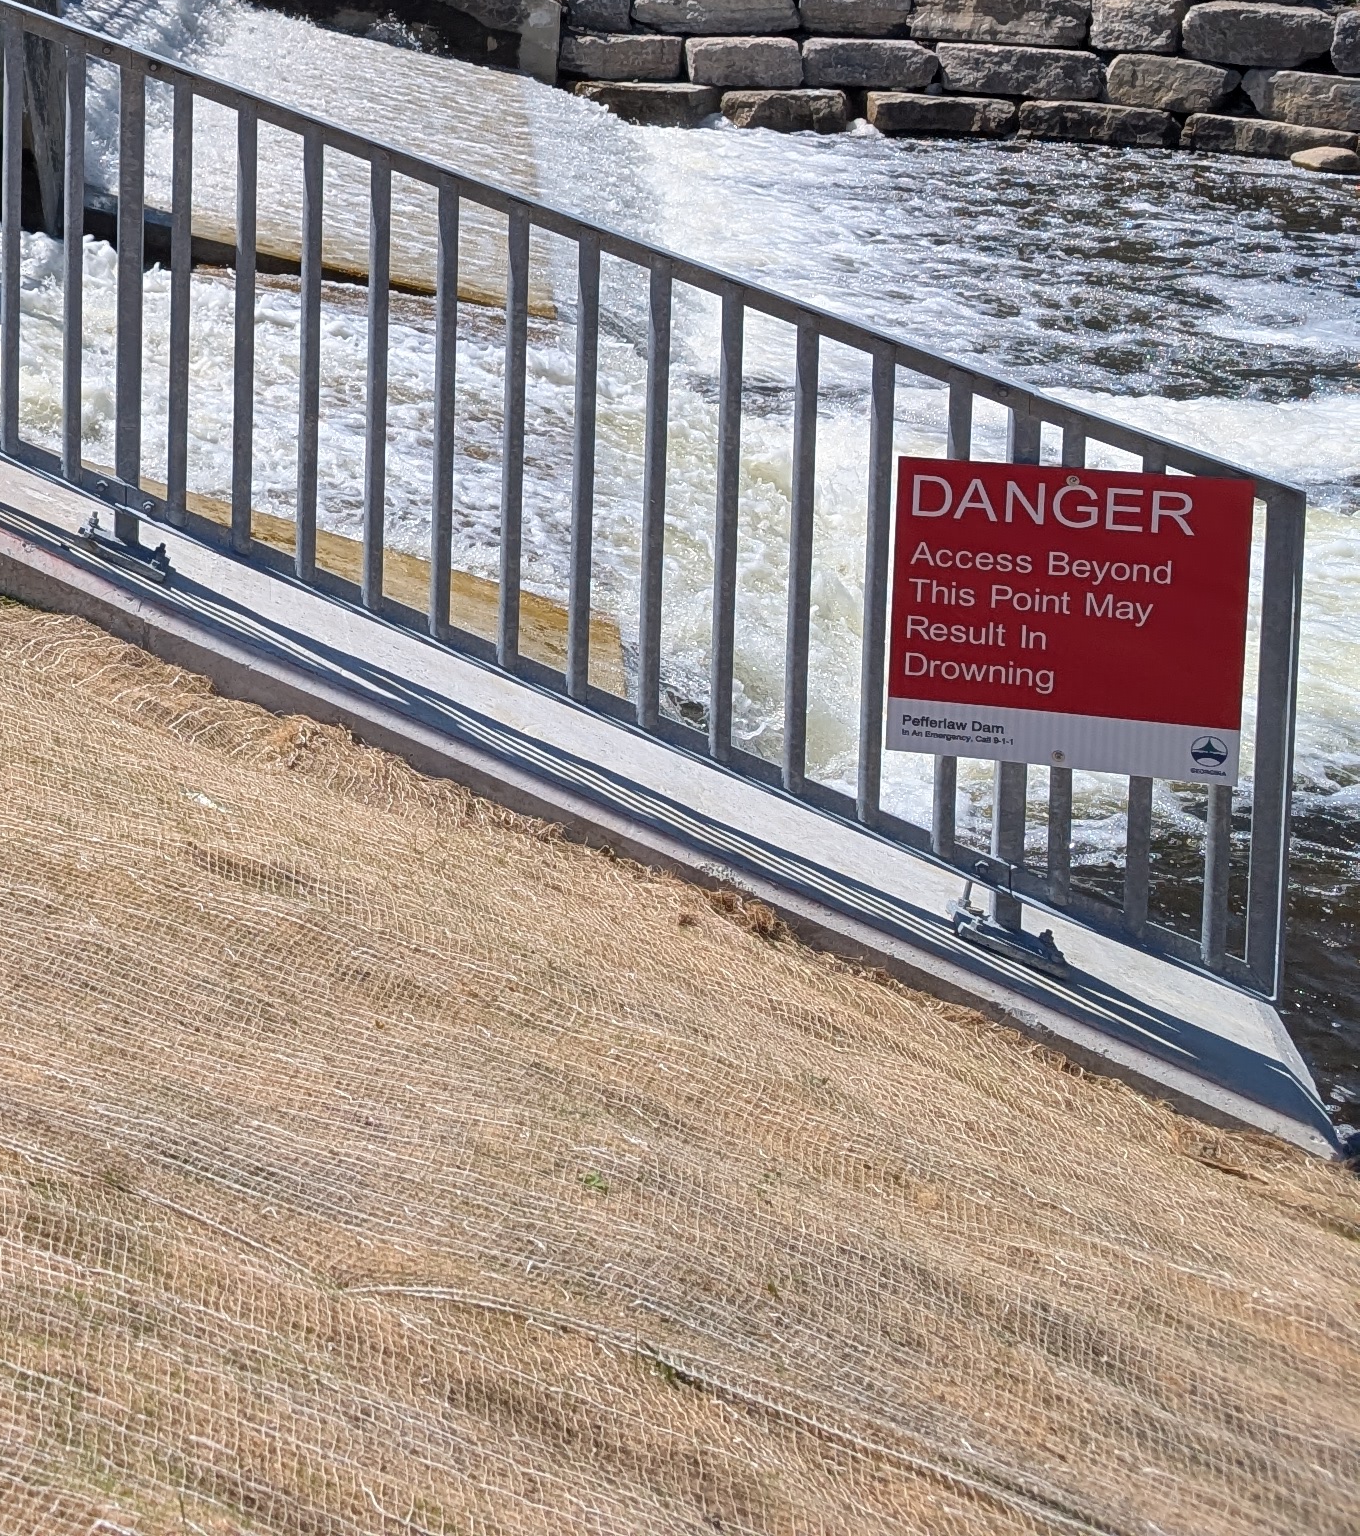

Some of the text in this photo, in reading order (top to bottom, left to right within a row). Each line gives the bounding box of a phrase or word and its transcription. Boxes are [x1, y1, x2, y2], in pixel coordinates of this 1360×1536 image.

[910, 474, 1195, 536] DANGER
[910, 541, 1173, 585] Access Beyond
[909, 578, 1154, 627] This Point May
[906, 615, 1047, 650] Result In
[904, 652, 1054, 695] Drowning
[902, 714, 1004, 734] Pefferlaw Dam
[925, 731, 973, 742] Emergency,
[993, 737, 1014, 745] 9-1-1
